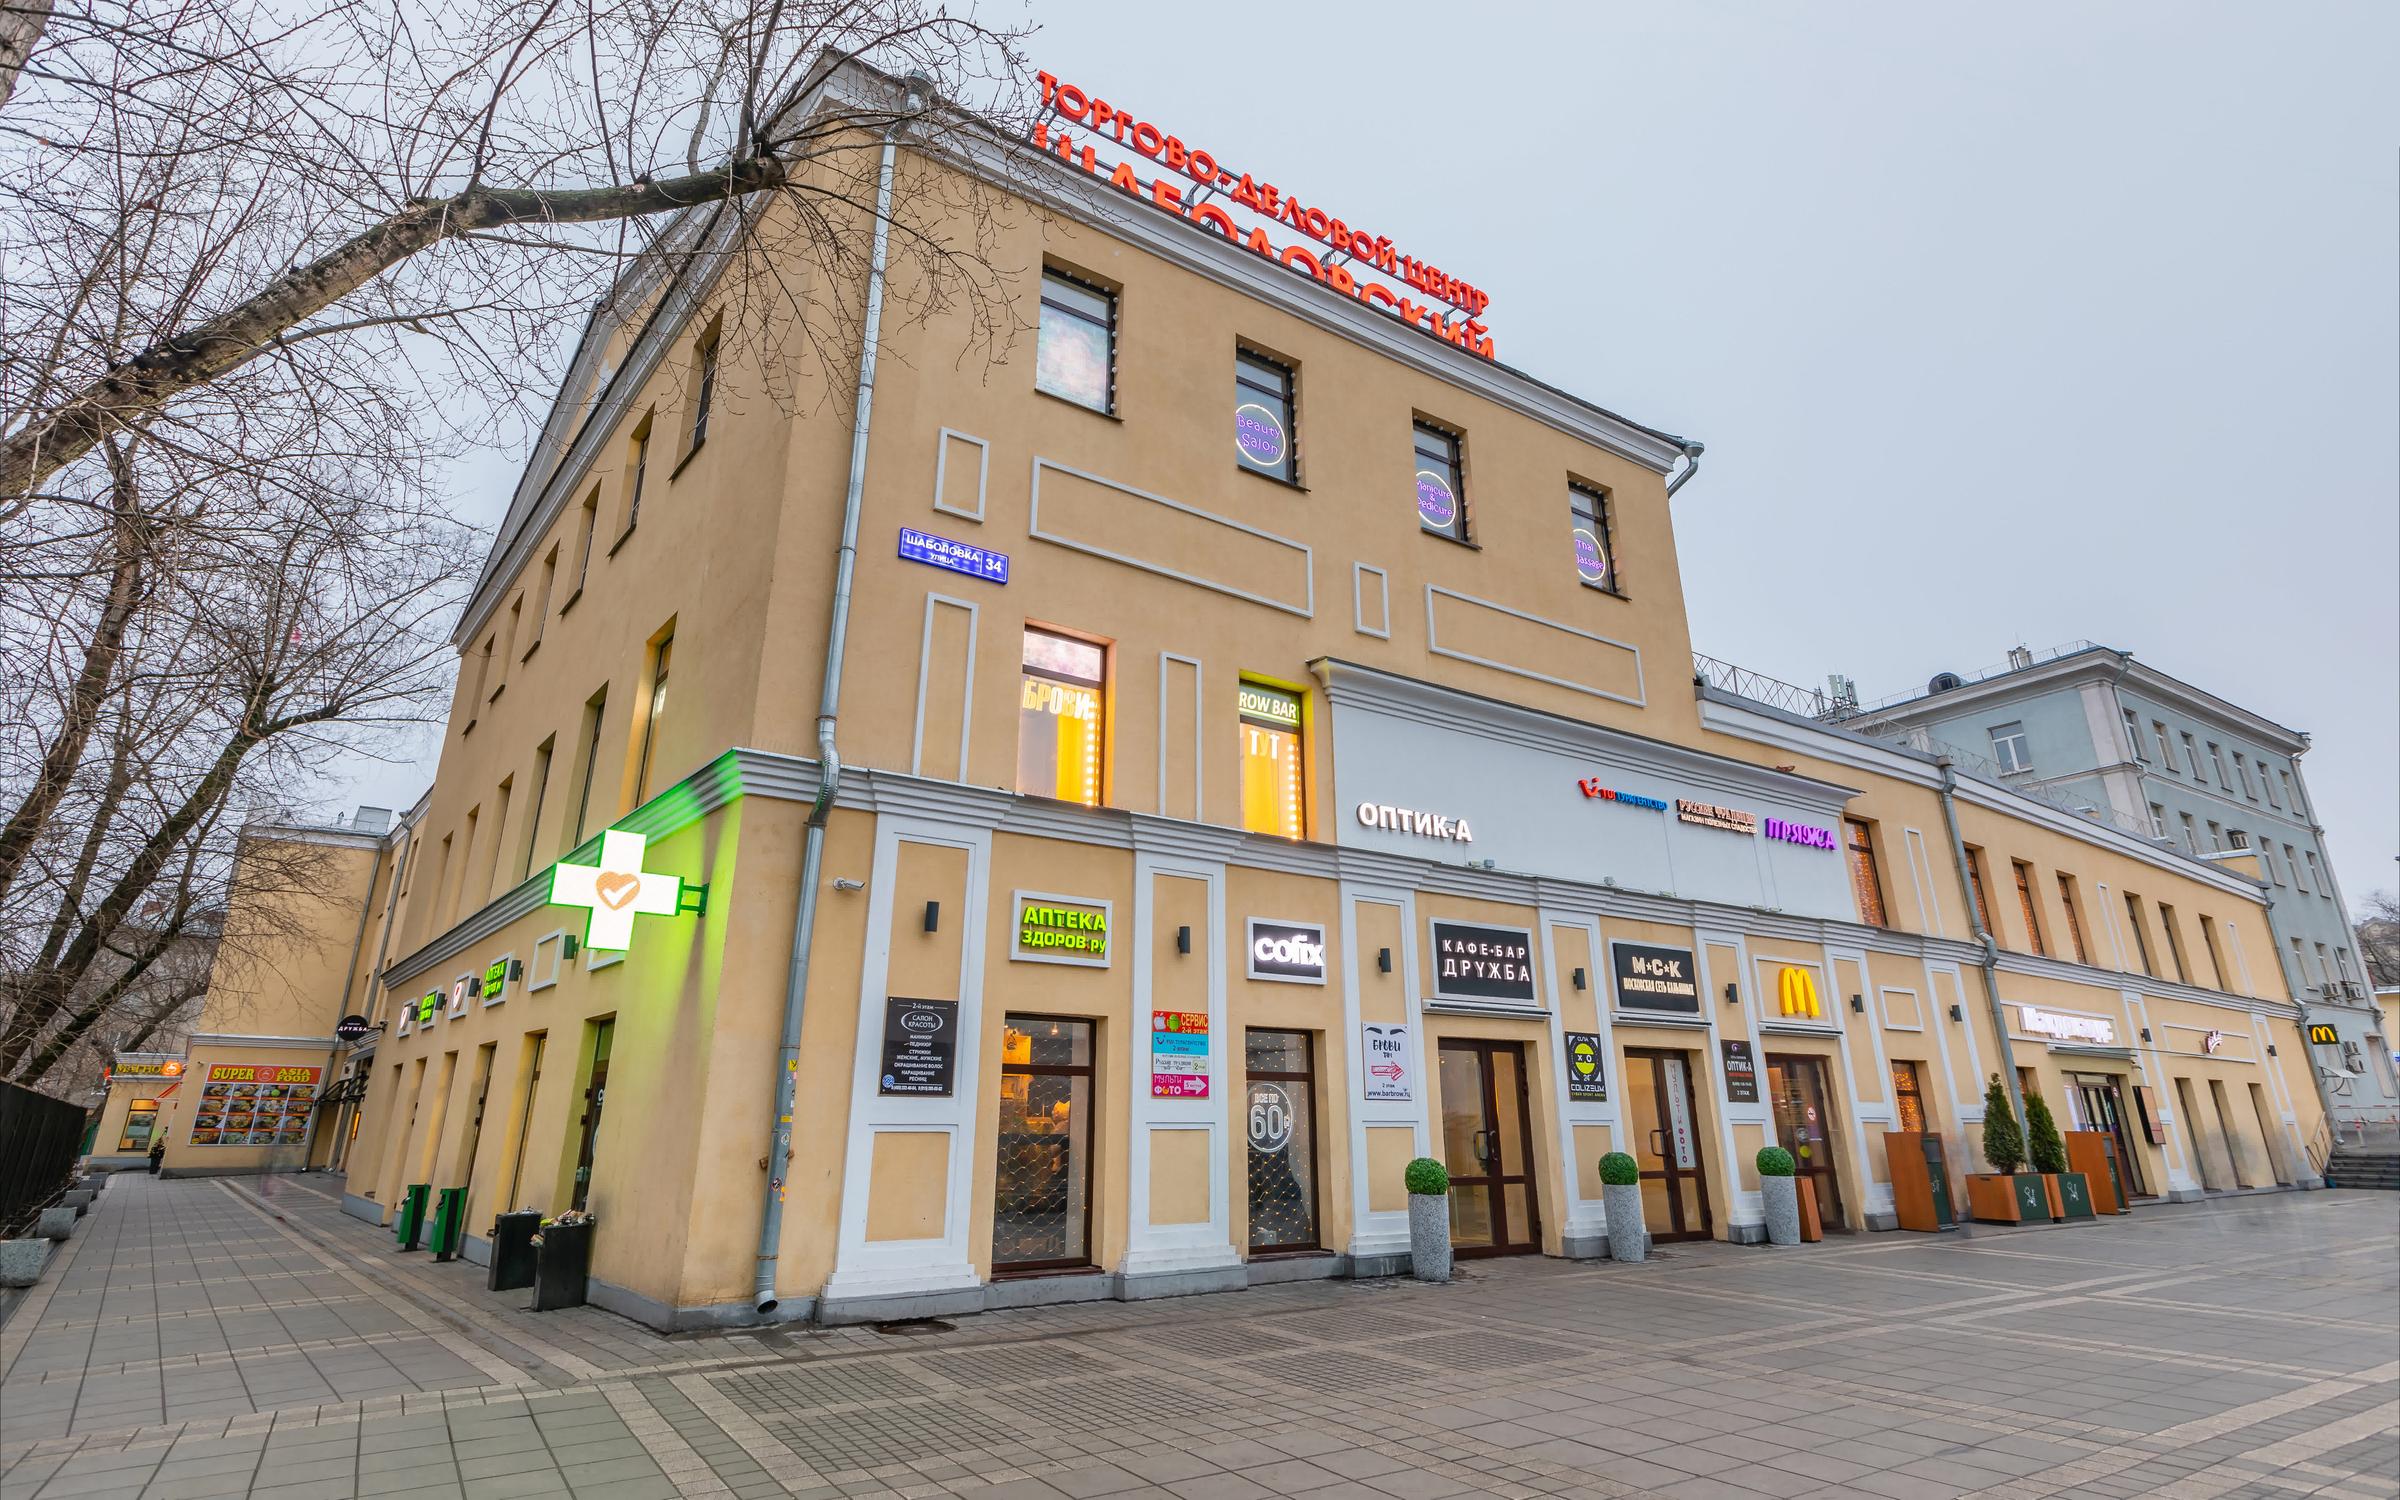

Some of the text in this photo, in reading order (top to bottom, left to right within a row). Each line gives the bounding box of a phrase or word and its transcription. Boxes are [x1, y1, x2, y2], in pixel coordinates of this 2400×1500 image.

[1037, 70, 1489, 318] ТОРГОВО-ДЕЛОВОЙ ЦЕНТР
[1241, 433, 1278, 456] Salon
[907, 534, 979, 563] ШАБОЛОВКА
[985, 558, 1002, 574] 34
[1022, 680, 1091, 721] БРОВИ
[1272, 699, 1297, 719] BAR
[1249, 730, 1280, 760] ТУТ
[1356, 802, 1473, 842] ОПТИК-А
[1765, 818, 1839, 850] ПРЯЖА
[1023, 906, 1107, 932] АПТЕКА
[1442, 958, 1531, 982] ДРУЖБА
[908, 1021, 936, 1029] КРАСОТЫ
[912, 1014, 933, 1022] САЛОН
[1181, 1013, 1208, 1027] СЕРВИС
[212, 1066, 255, 1081] SUPER
[275, 1075, 311, 1083] FOOD
[278, 1067, 311, 1076] ASIA
[1154, 1074, 1182, 1084] МУЛЬТИ
[1570, 1083, 1605, 1092] COLIZEUM
[1250, 1104, 1284, 1140] 60
